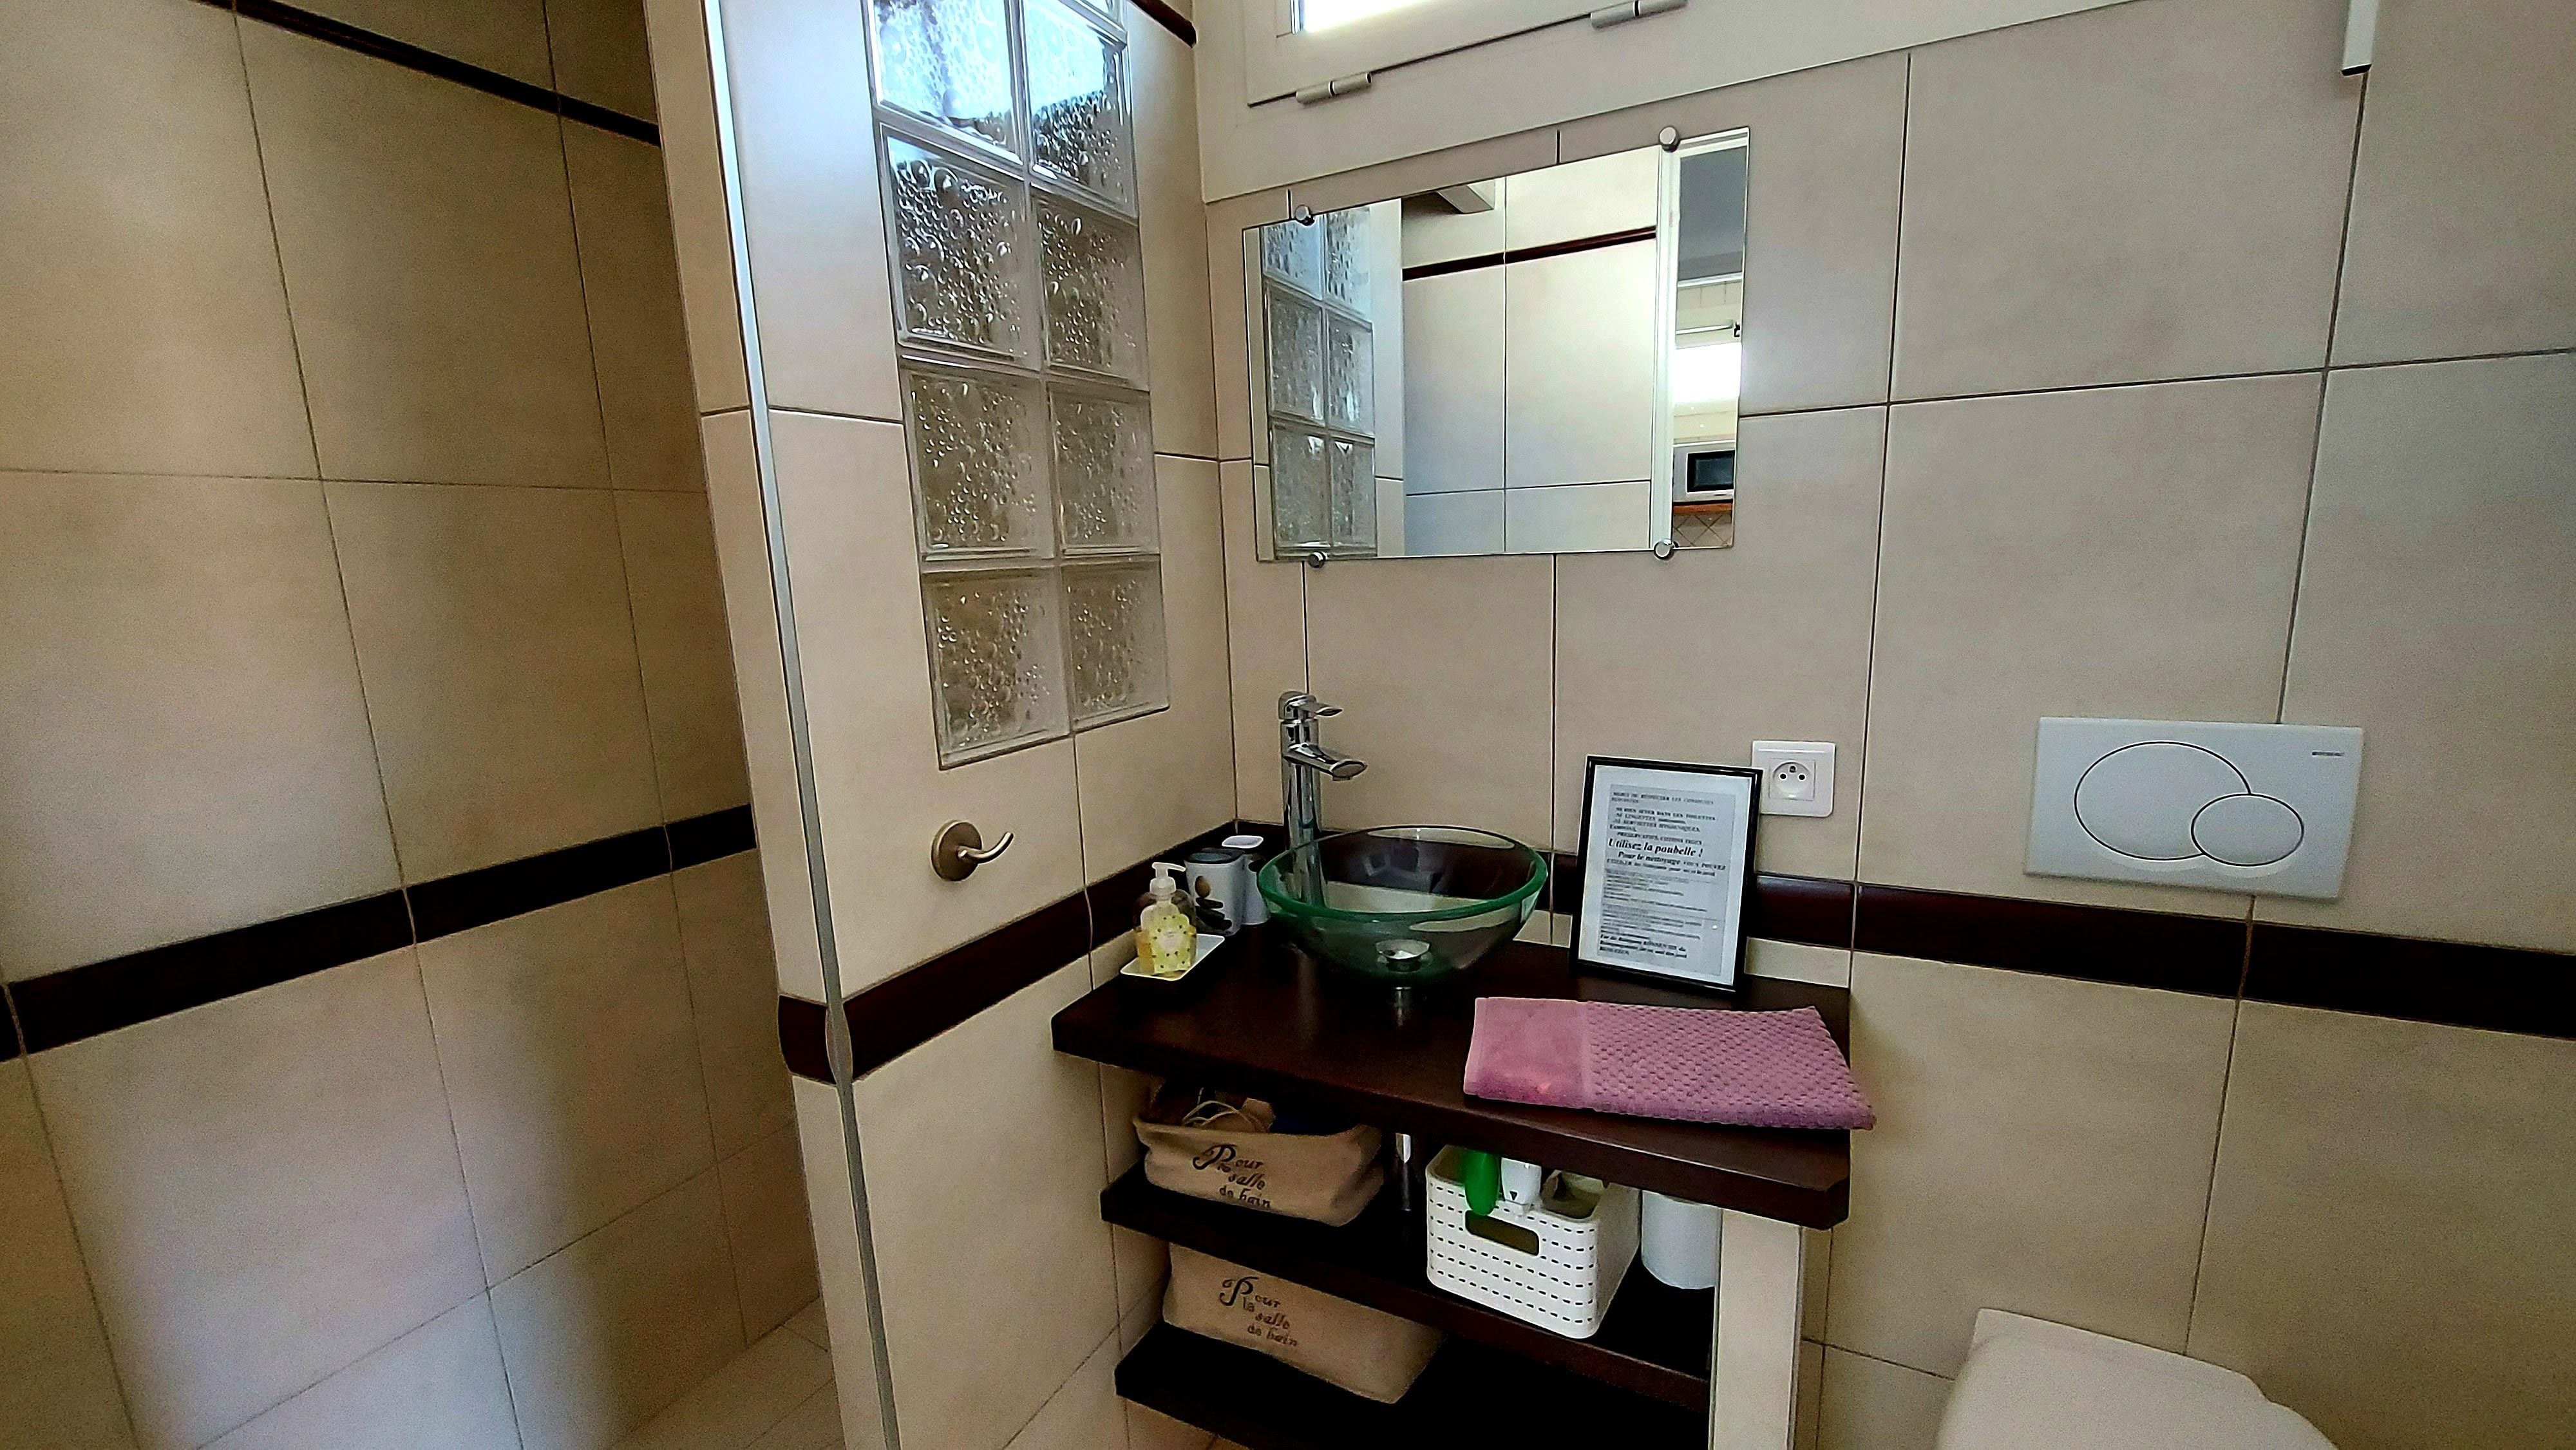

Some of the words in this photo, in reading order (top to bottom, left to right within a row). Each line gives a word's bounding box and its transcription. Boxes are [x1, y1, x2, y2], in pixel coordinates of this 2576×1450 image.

[1609, 838, 1642, 851] Utilisez
[1644, 842, 1653, 851] la
[1654, 845, 1696, 856] poubelle
[1193, 1144, 1264, 1170] Pour
[1228, 1172, 1265, 1190] salle
[1238, 1189, 1271, 1208] bain
[1219, 1276, 1281, 1308] Pour
[1243, 1297, 1255, 1312] la
[1255, 1312, 1290, 1330] salle
[1247, 1323, 1262, 1336] de
[1266, 1327, 1298, 1346] bain
